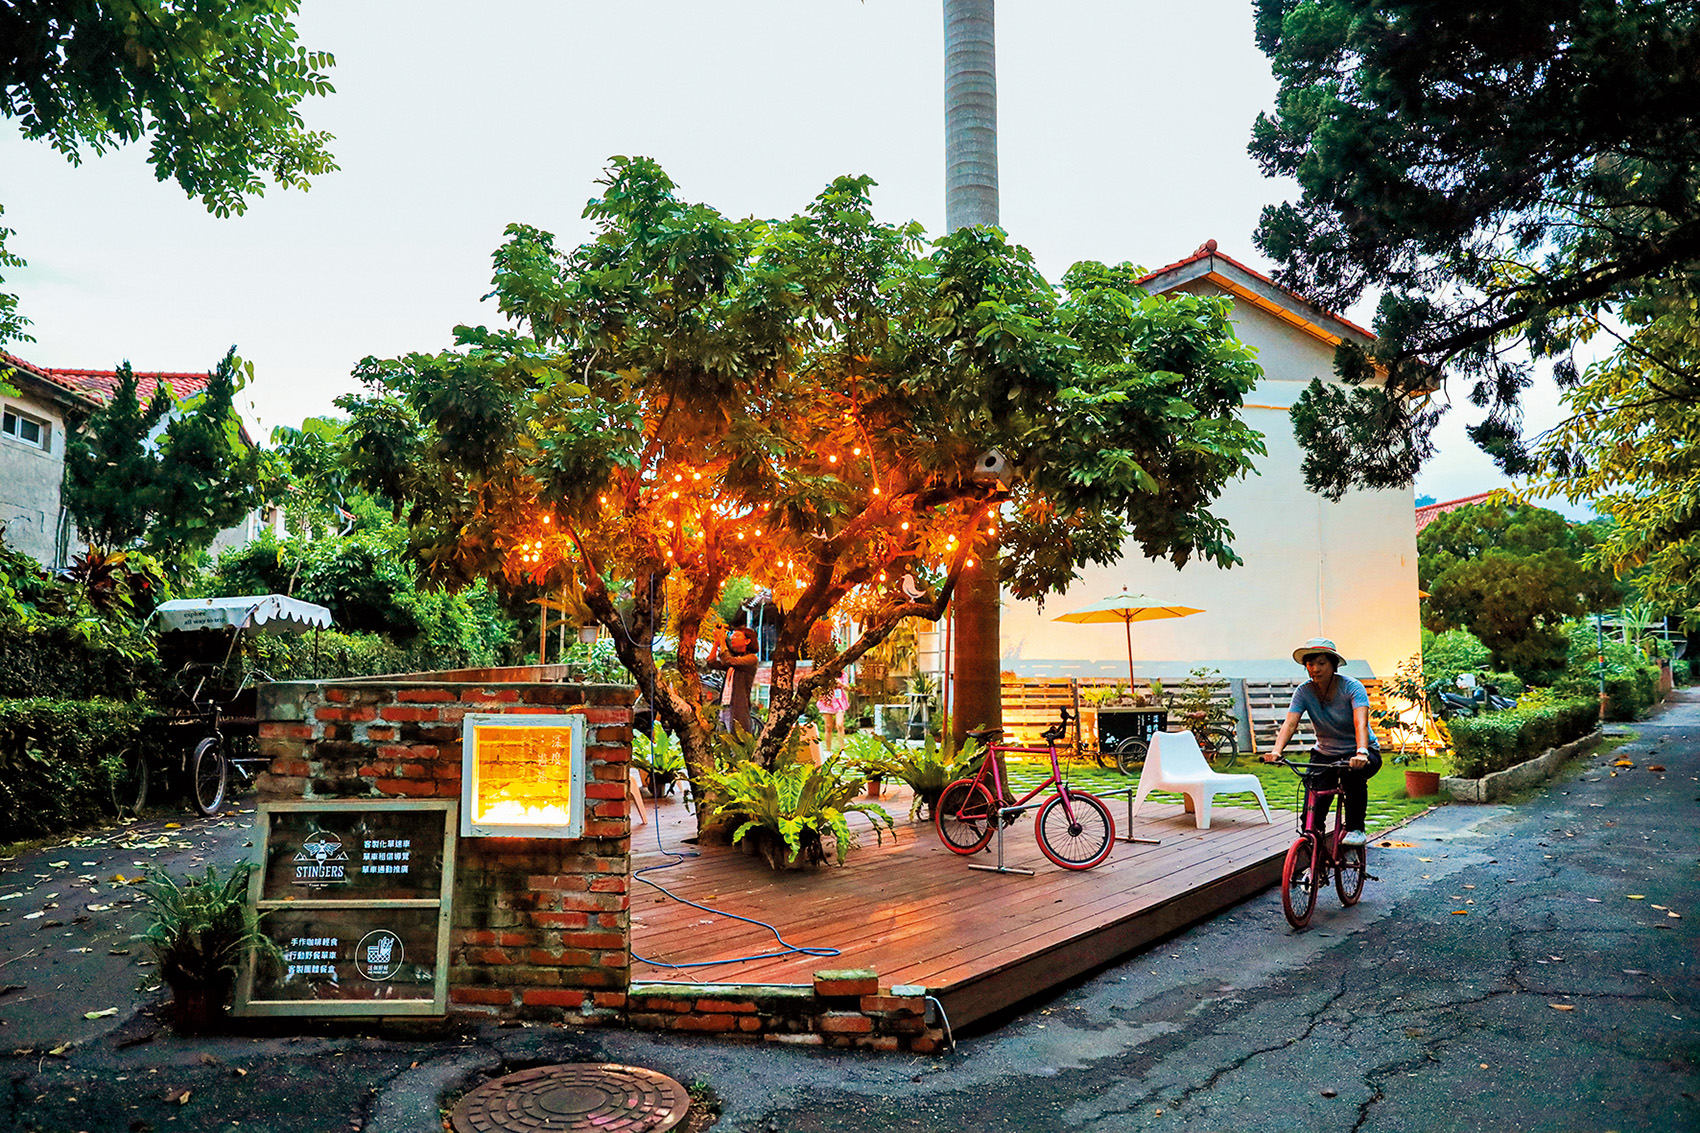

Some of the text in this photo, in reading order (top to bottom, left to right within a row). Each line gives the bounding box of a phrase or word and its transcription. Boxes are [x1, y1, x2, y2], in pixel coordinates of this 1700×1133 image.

[551, 734, 562, 766] 深度
[296, 865, 344, 878] STINGERS
[291, 938, 338, 946] 手作咖啡輕食
